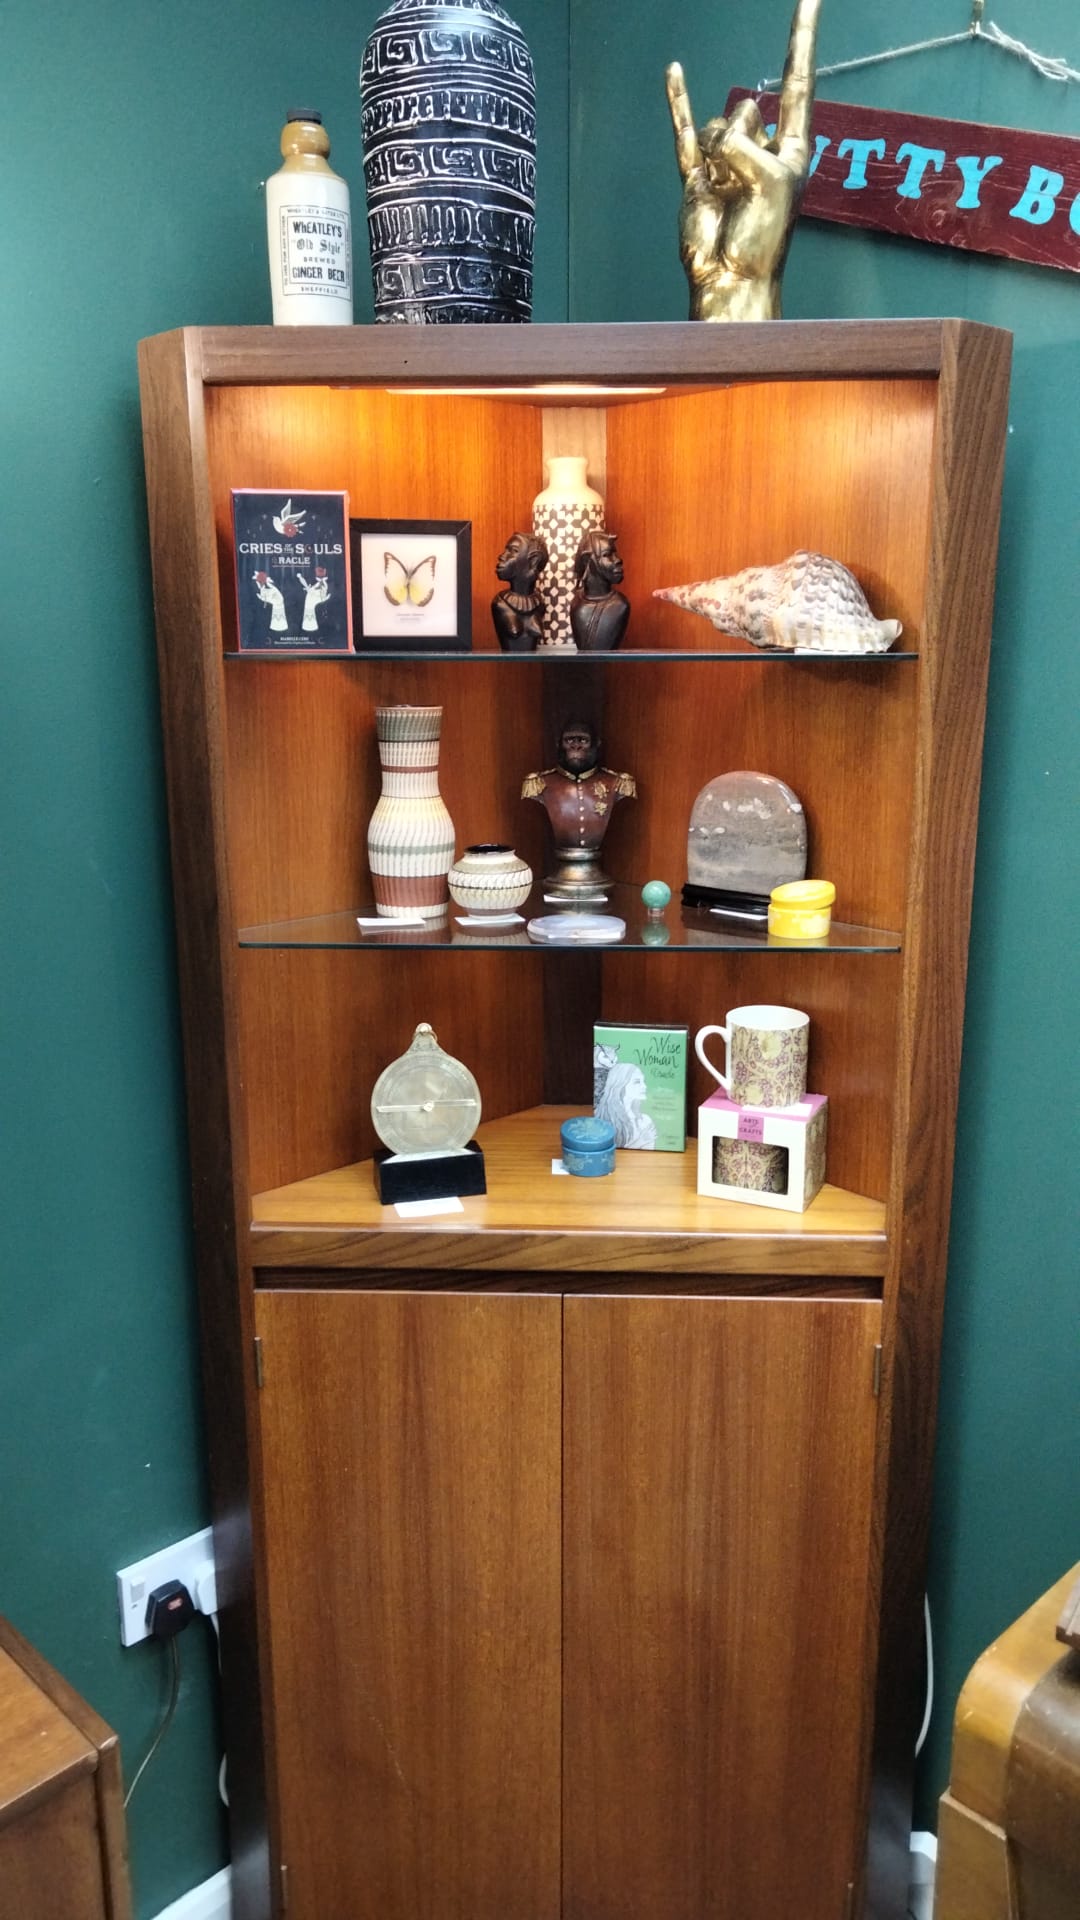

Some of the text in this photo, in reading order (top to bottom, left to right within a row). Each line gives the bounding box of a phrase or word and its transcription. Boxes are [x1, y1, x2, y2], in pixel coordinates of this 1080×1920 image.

[303, 256, 336, 265] BREWED
[292, 266, 345, 282] GINGER BEER
[301, 286, 338, 294] SHEFFIELD
[239, 542, 283, 554] CRIES
[652, 1034, 680, 1055] Wise
[633, 1046, 680, 1069] Woman
[738, 1126, 763, 1136] CRAFTS
